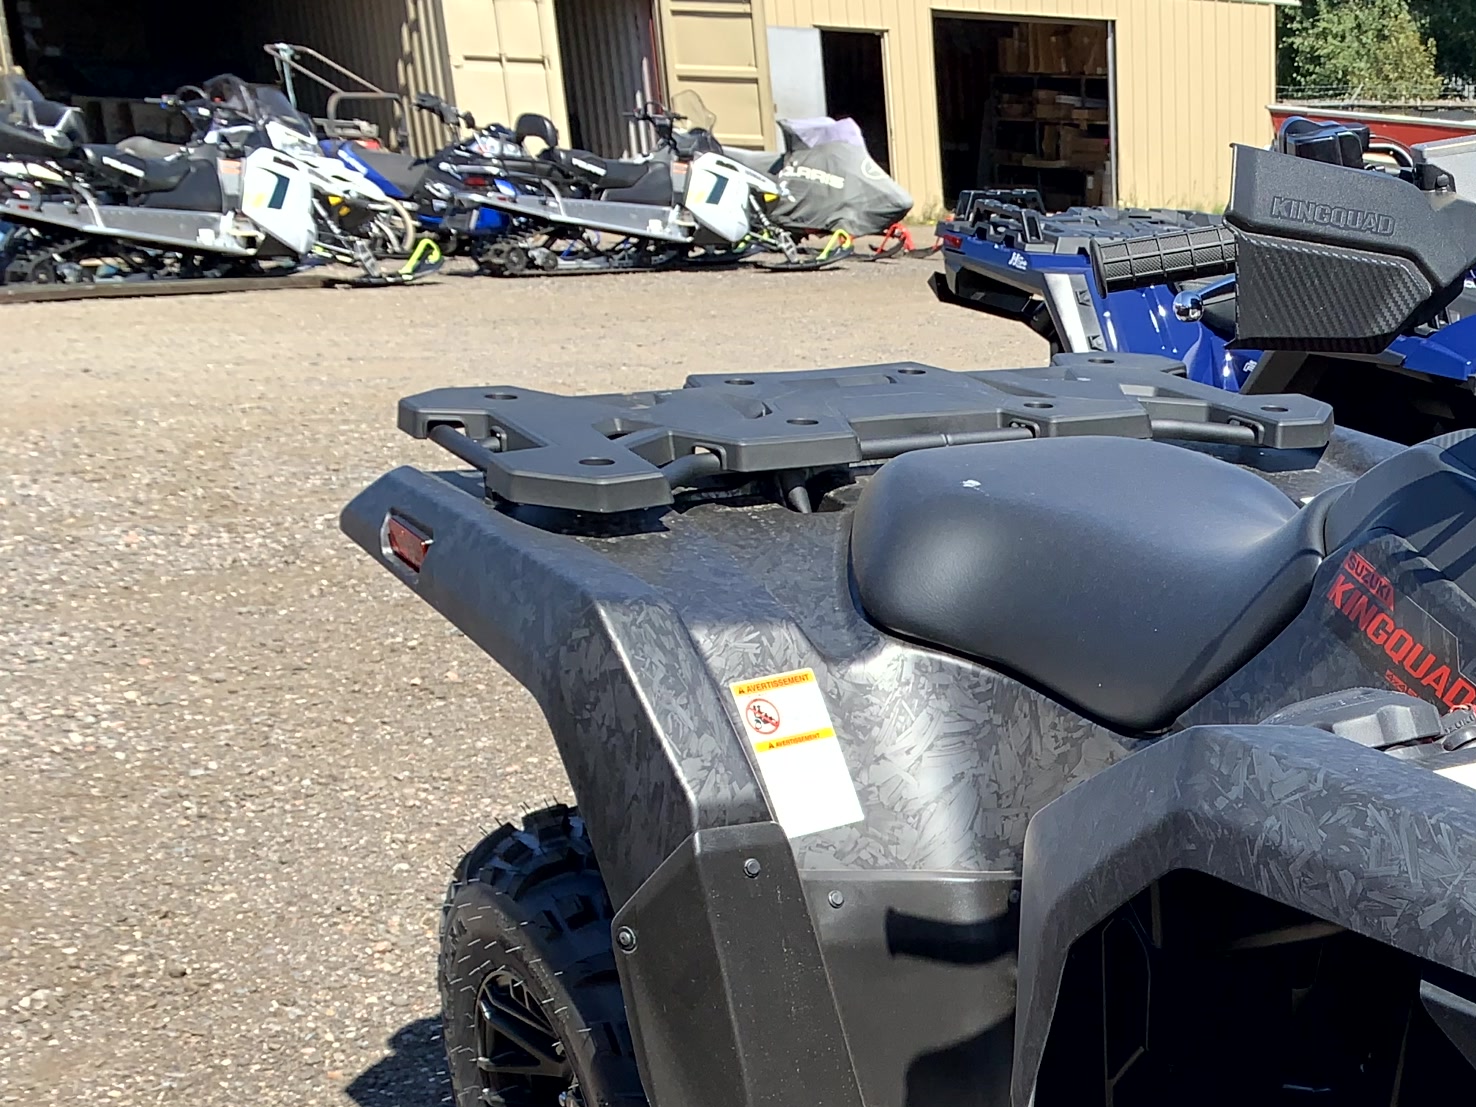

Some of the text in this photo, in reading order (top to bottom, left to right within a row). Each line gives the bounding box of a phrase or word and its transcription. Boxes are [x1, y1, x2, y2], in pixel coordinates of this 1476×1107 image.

[1271, 196, 1397, 237] KINGQUAD
[1348, 552, 1394, 604] SUZUKI
[1327, 574, 1476, 712] KINGQUAD
[746, 673, 810, 693] AVERTISSEMENT
[774, 732, 821, 749] AVERTISSEMENT
